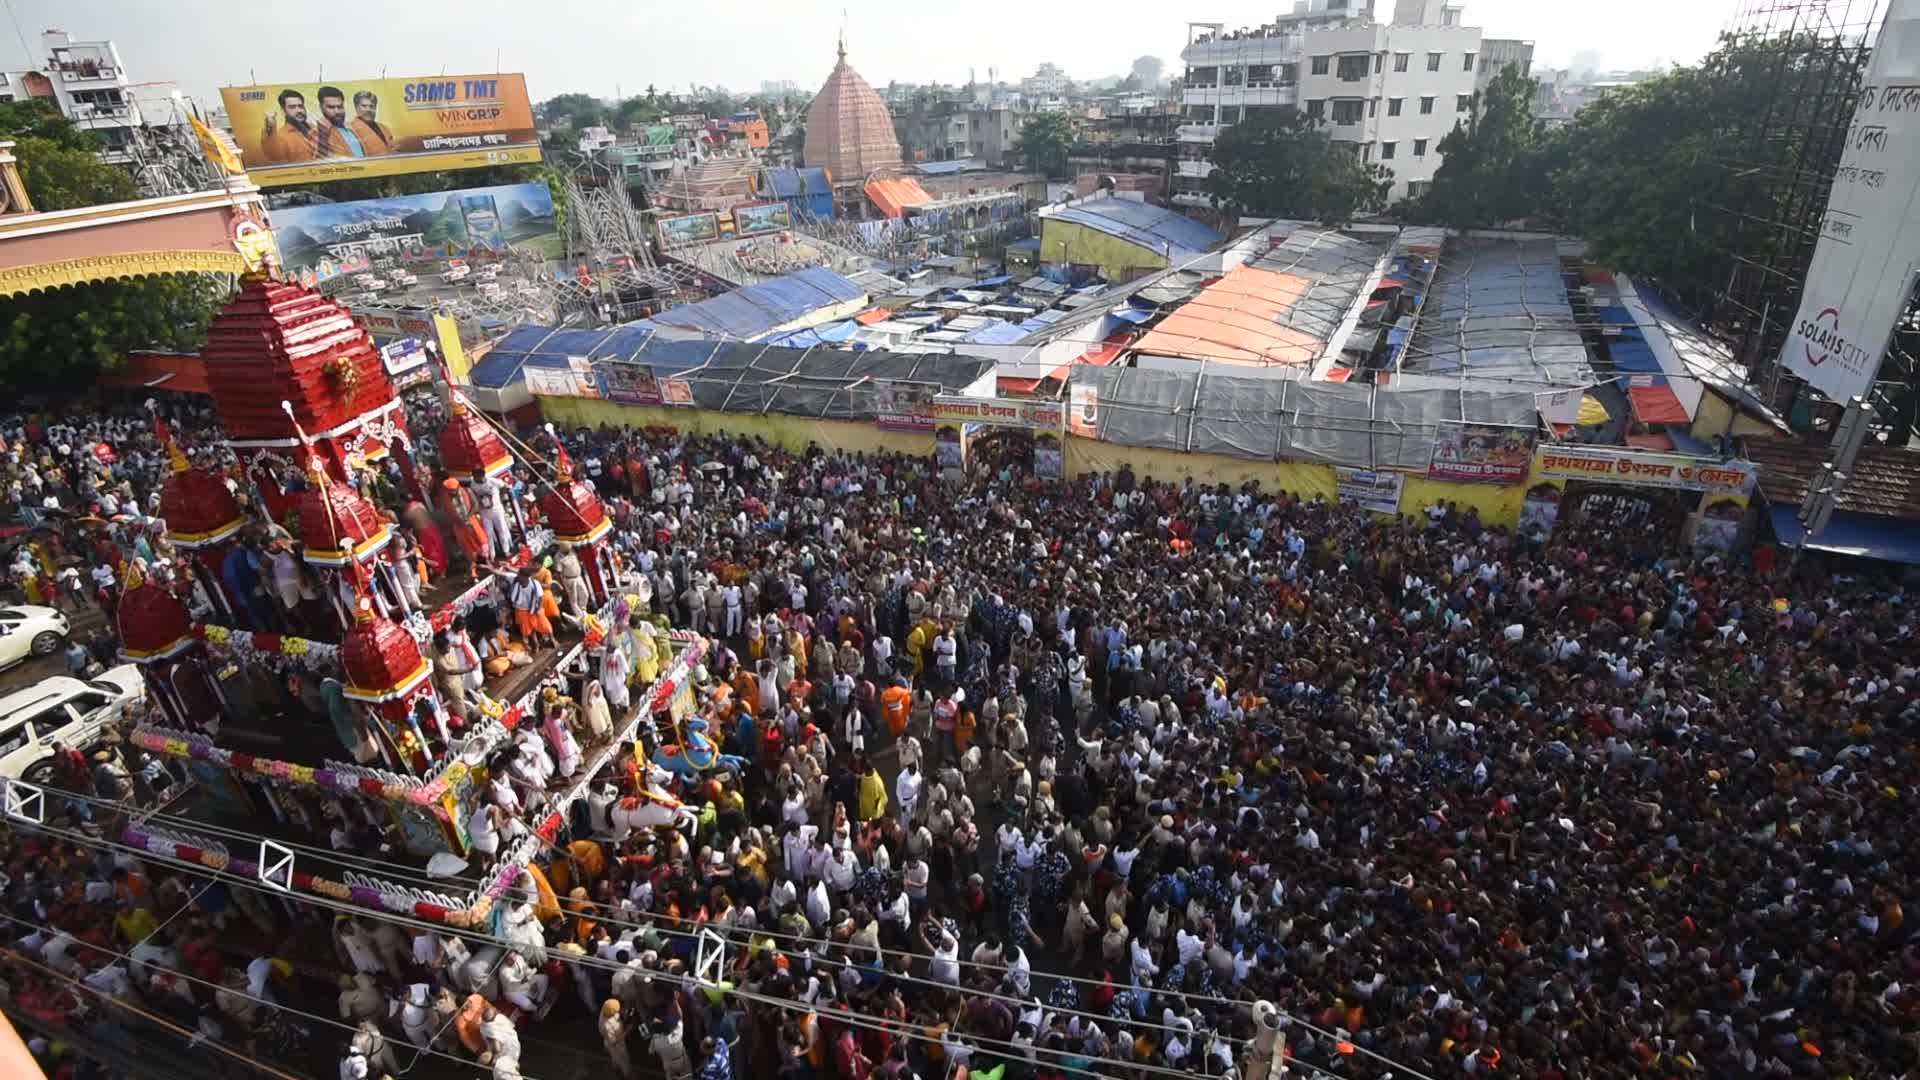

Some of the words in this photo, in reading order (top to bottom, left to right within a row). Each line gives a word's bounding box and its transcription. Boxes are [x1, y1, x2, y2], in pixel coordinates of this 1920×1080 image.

[404, 81, 456, 103] SRMB
[464, 80, 498, 99] TMT
[436, 108, 500, 122] WINGRIP
[1843, 344, 1870, 370] CITY
[1542, 454, 1614, 474] রথযাত্রা
[1616, 457, 1675, 478] উৎসব
[1679, 466, 1693, 480] ও
[1696, 467, 1745, 488] মেলা
